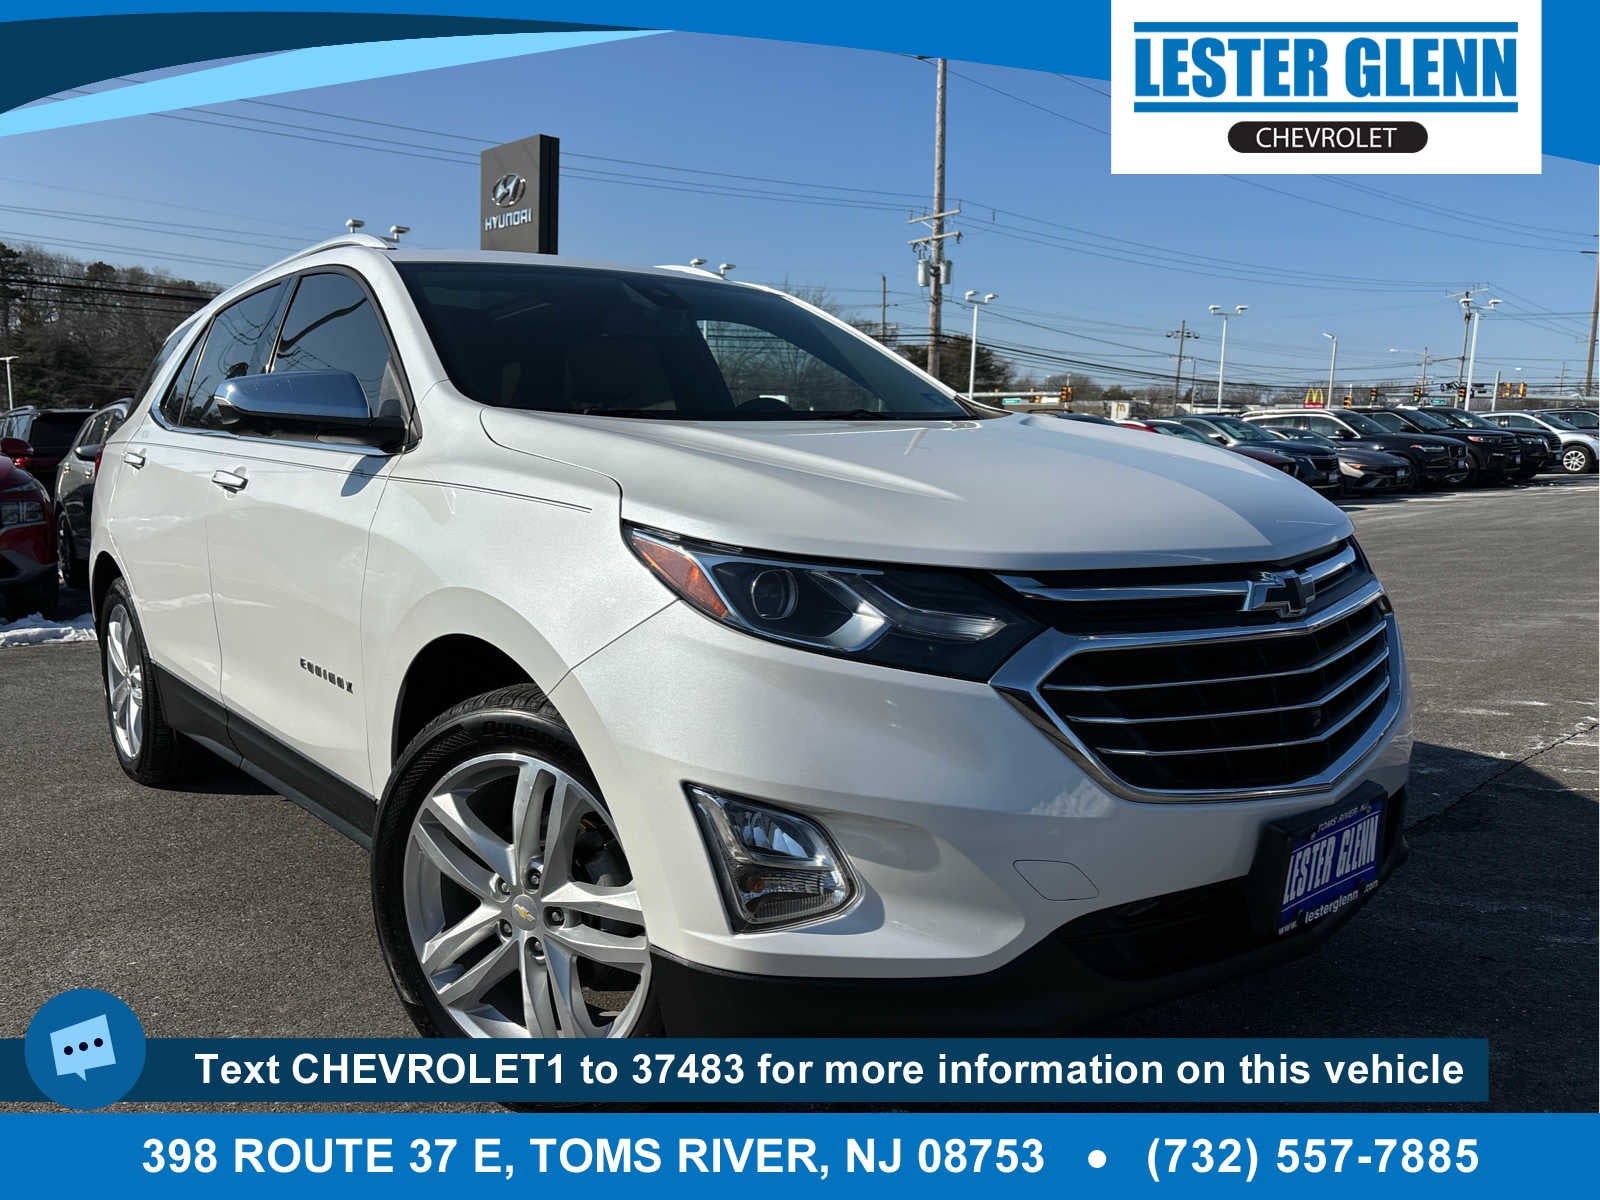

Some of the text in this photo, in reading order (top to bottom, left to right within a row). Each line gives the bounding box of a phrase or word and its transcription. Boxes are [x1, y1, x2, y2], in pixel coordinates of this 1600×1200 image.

[484, 207, 532, 231] HYUNDAI
[1282, 814, 1380, 905] LESTER GLENN
[1304, 889, 1360, 925] lesterglenn
